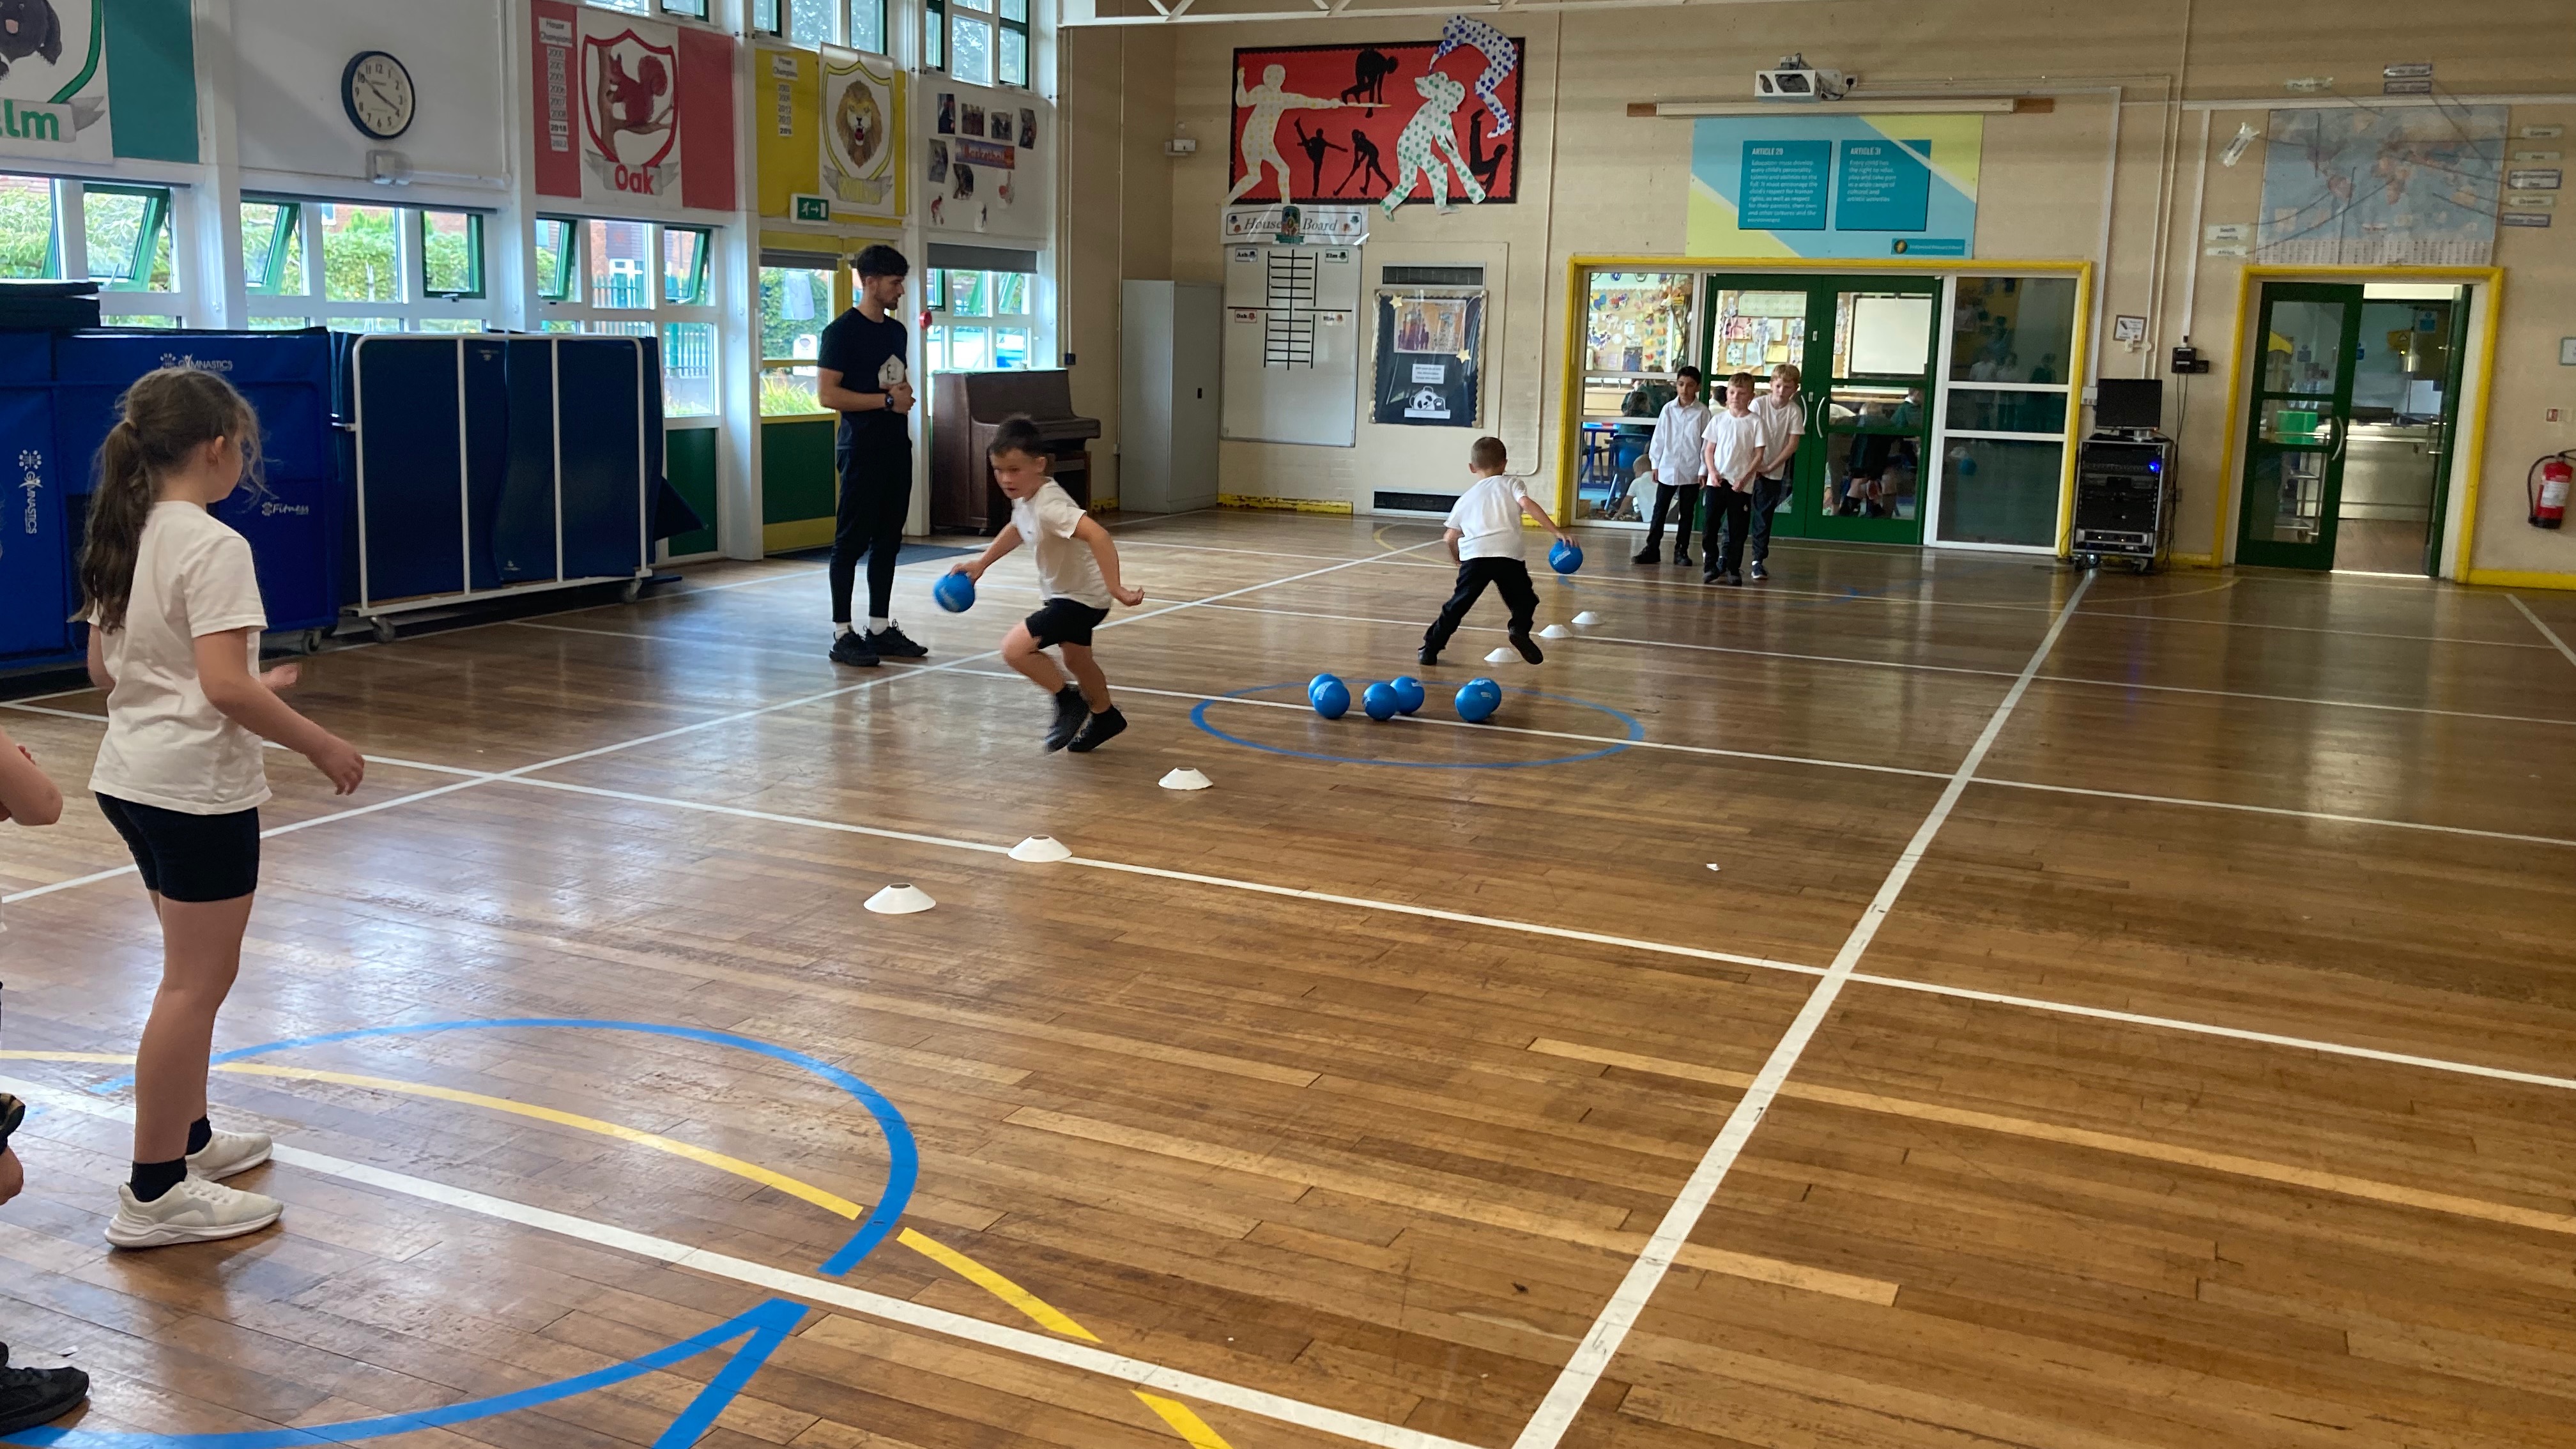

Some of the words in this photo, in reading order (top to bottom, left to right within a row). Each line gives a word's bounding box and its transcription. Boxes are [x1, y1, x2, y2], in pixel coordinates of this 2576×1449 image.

[0, 99, 60, 141] lm
[1752, 148, 1775, 156] ARTICLE
[1850, 147, 1874, 155] ARTICLE
[1874, 147, 1881, 155] 31
[615, 164, 654, 194] Oak
[1244, 217, 1281, 231] House
[1302, 218, 1338, 231] Board
[178, 354, 233, 371] GYMNASTICS
[24, 471, 40, 534] GYMNASTICS
[273, 502, 309, 514] Fitness
